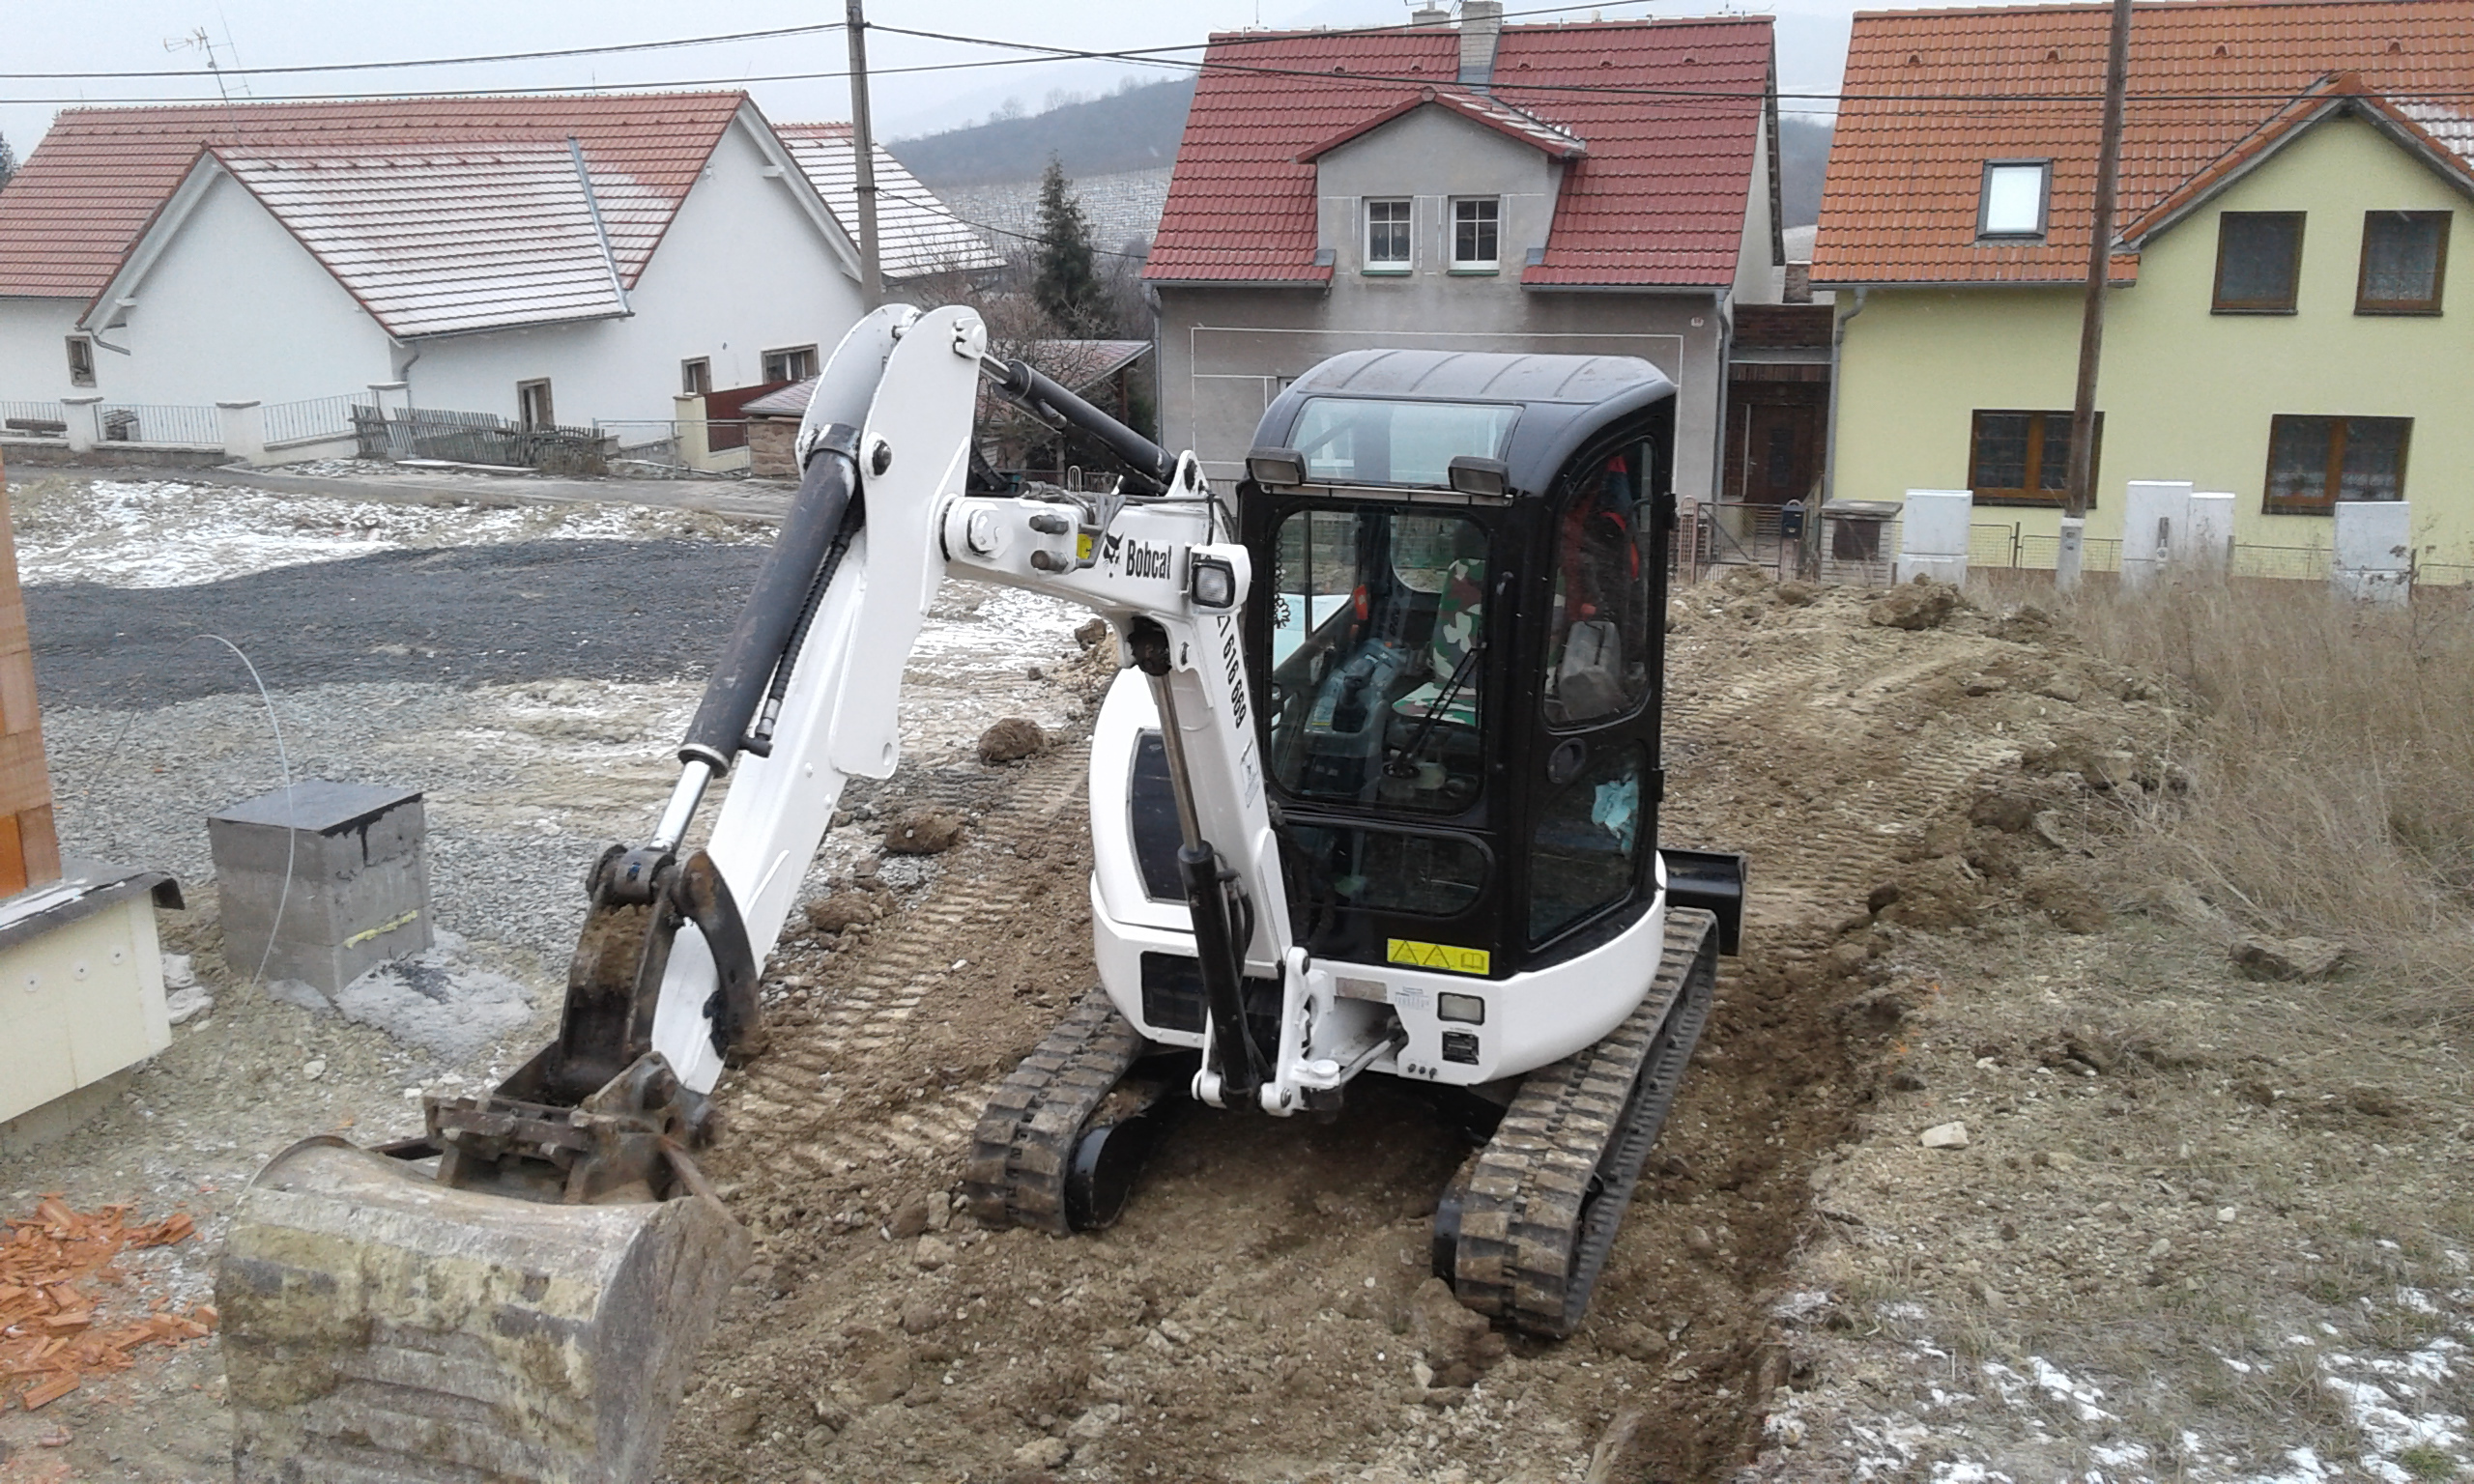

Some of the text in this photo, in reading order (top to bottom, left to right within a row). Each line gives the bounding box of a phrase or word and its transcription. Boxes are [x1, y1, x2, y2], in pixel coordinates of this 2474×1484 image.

[1126, 539, 1172, 580] Bobcat
[1223, 634, 1239, 685] 616
[1231, 678, 1247, 729] 669
